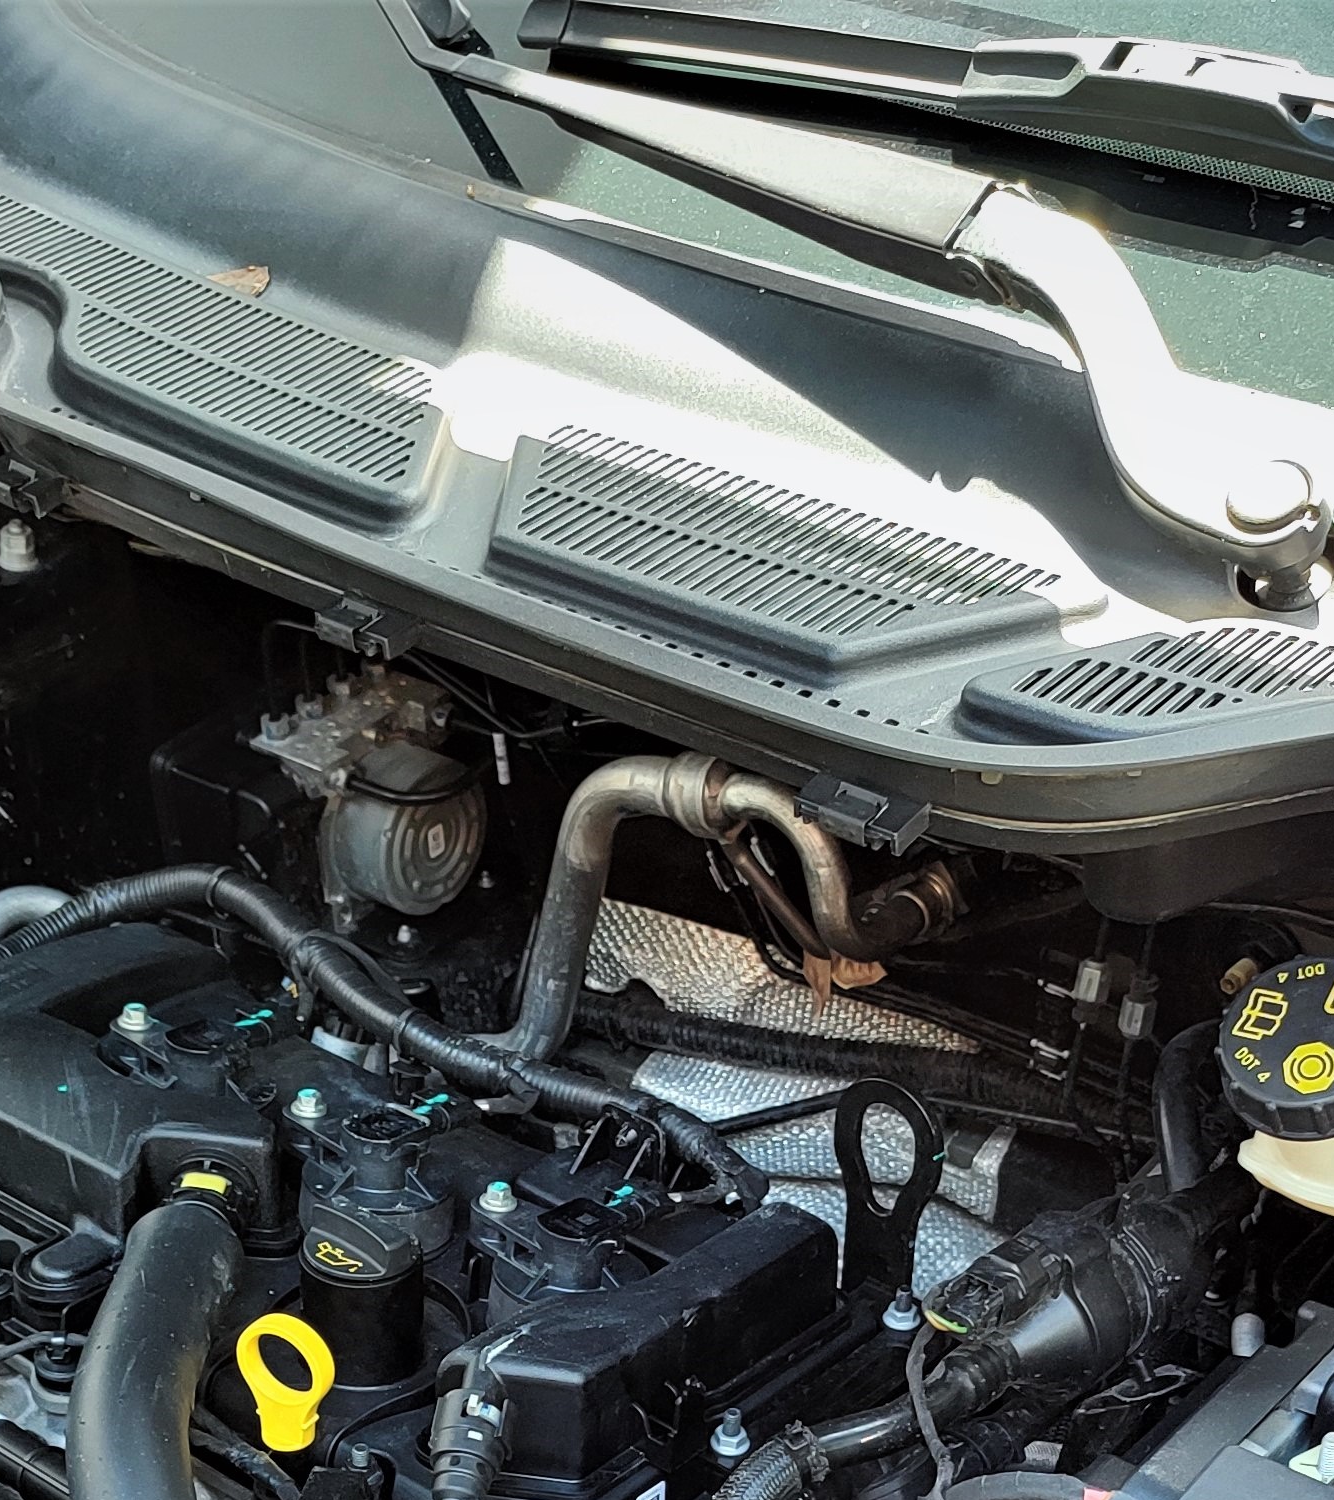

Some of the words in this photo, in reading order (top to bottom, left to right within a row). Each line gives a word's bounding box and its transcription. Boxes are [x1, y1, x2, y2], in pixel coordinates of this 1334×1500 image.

[1276, 971, 1289, 984] 4
[1296, 963, 1326, 980] DOT
[1234, 1046, 1261, 1071] DOT
[1256, 1071, 1271, 1083] 4
